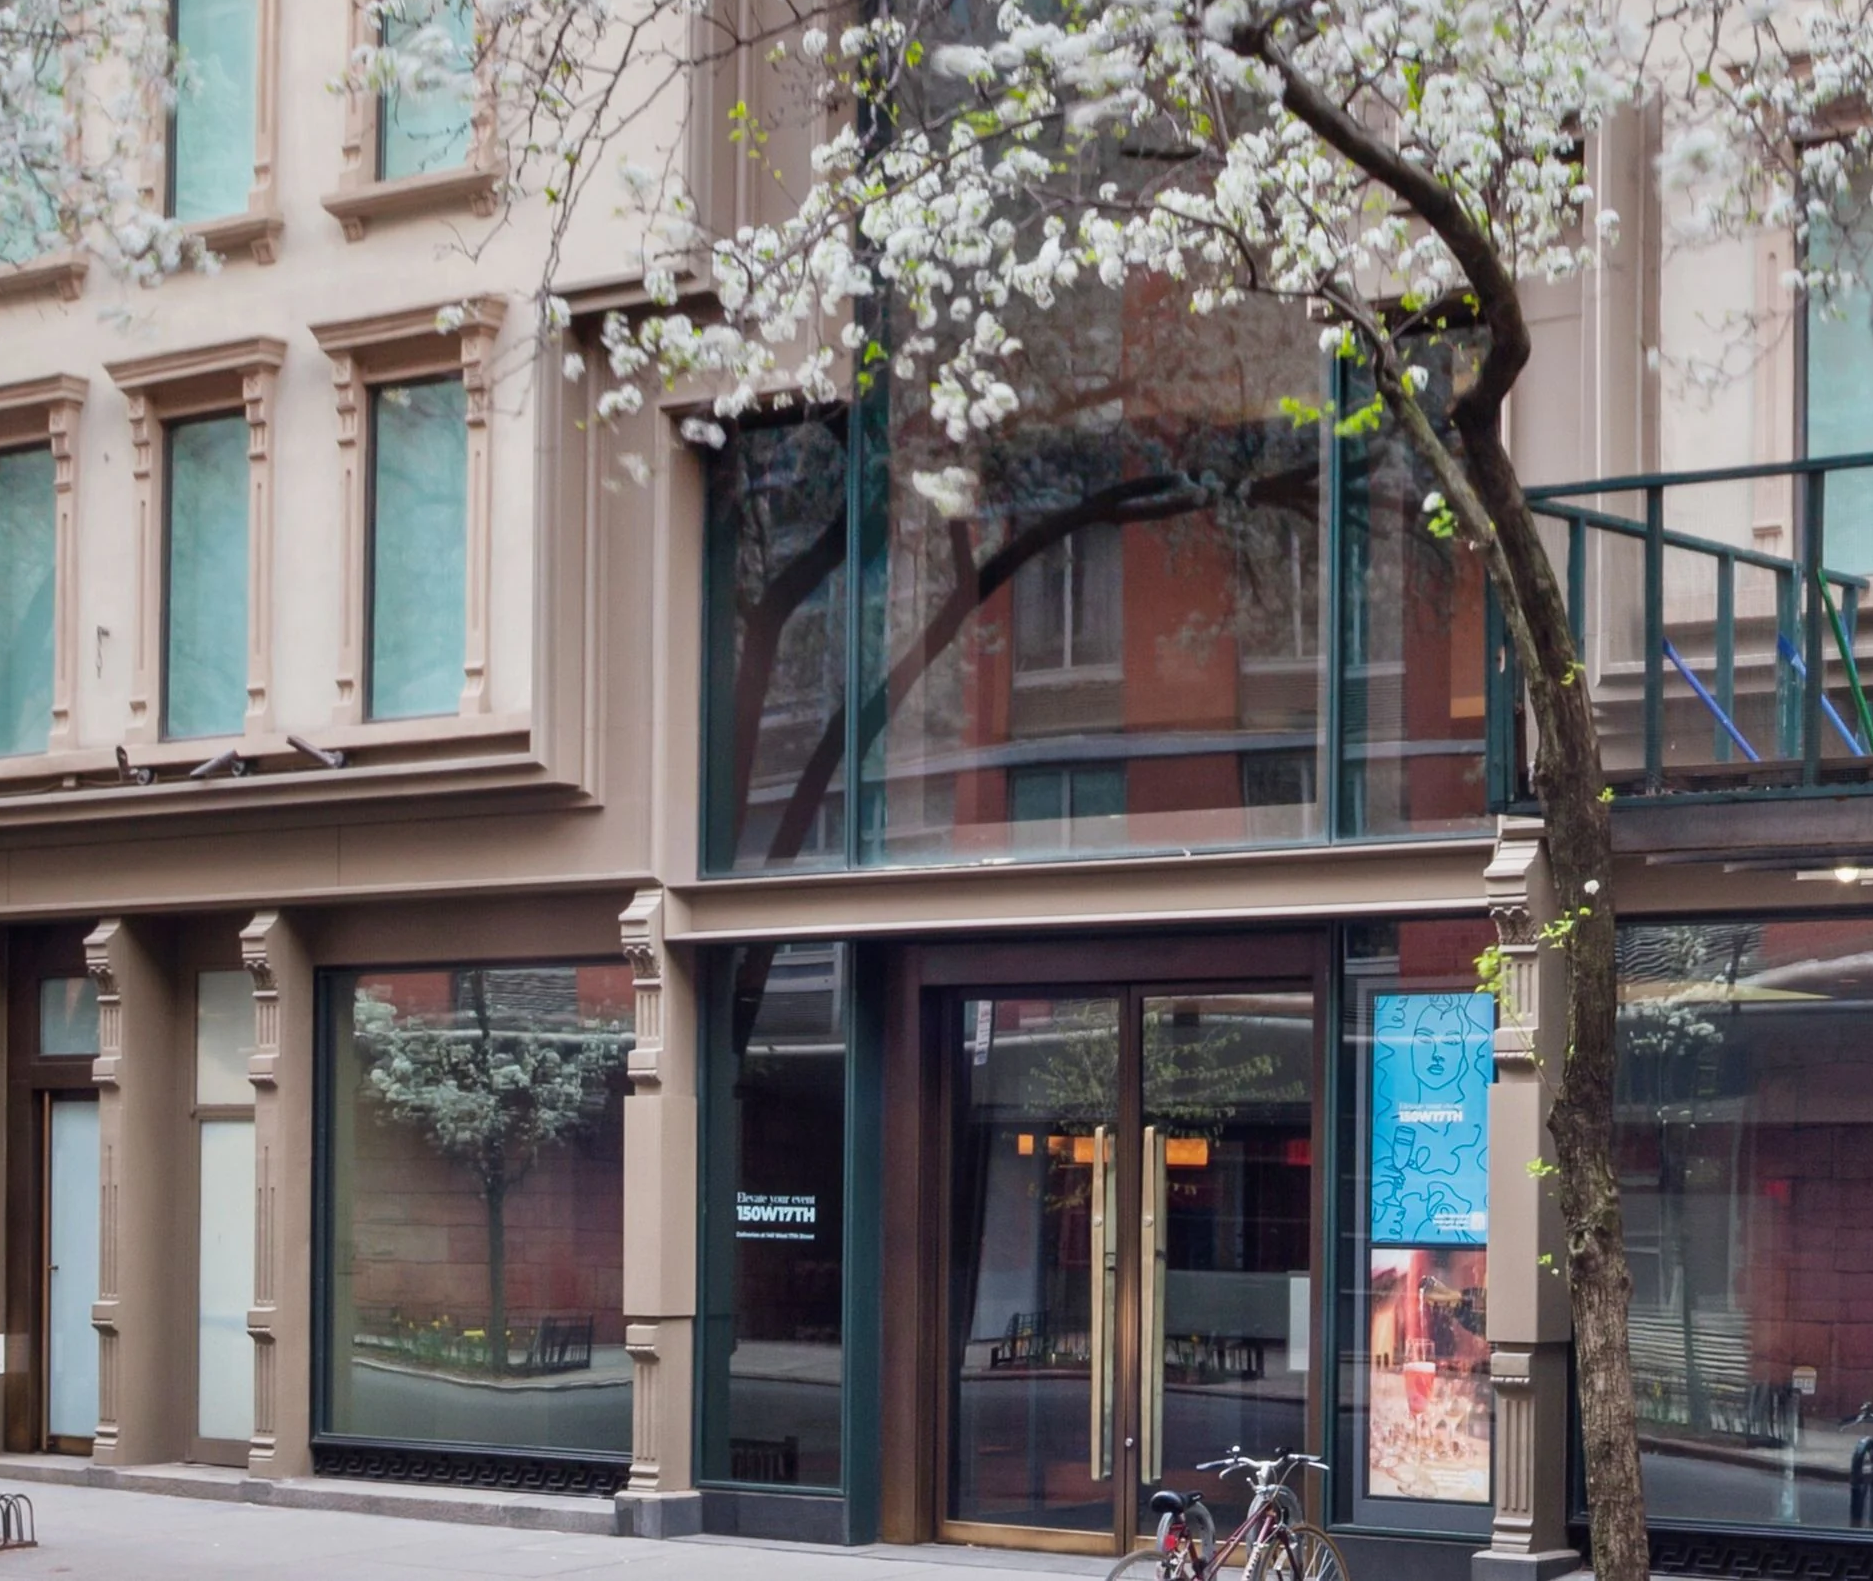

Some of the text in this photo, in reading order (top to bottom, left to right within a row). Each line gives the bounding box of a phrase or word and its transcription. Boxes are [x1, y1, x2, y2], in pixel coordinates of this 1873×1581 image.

[736, 1191, 816, 1207] Elevate your event
[735, 1205, 816, 1223] 150W17TH
